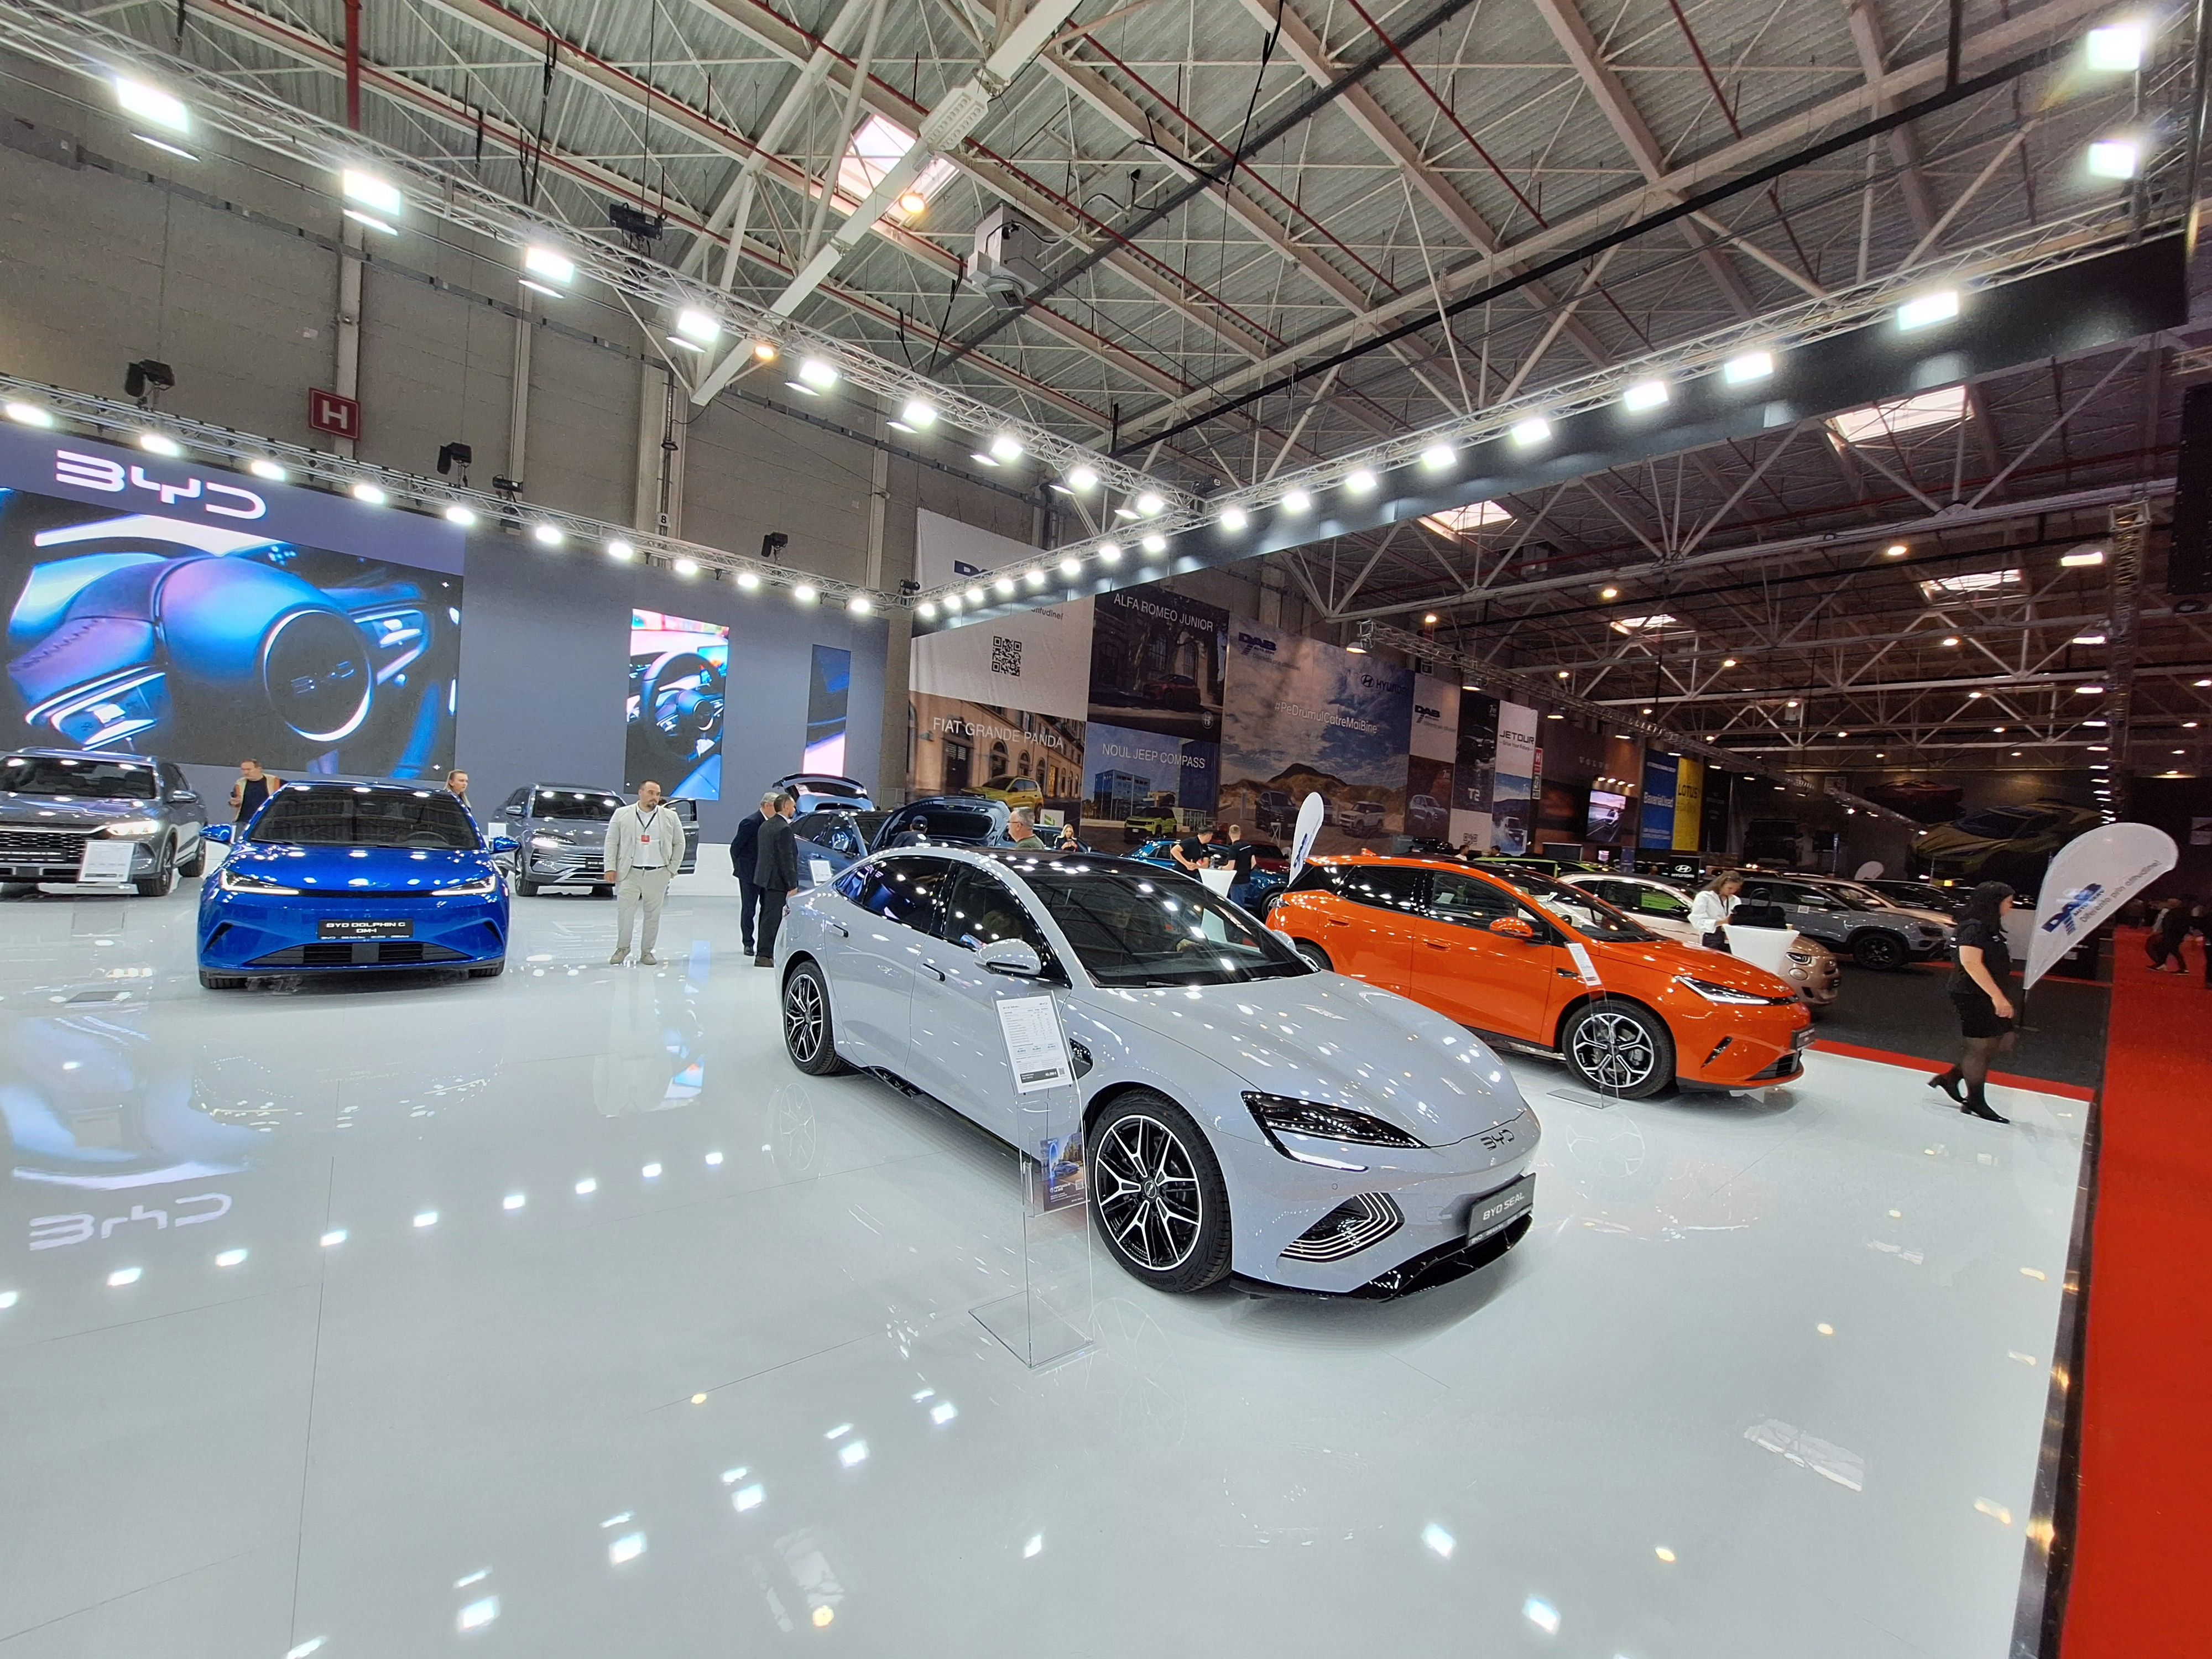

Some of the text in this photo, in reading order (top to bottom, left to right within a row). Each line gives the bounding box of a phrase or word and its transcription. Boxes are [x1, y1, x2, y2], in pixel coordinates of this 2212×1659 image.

[322, 400, 348, 430] H
[56, 449, 267, 520] BYD
[661, 515, 667, 524] 8
[1113, 593, 1214, 633] ALFA ROMEO JUNIOR
[1239, 632, 1277, 651] DAB
[1274, 702, 1378, 734] #PeDrumulCatreMaiBine
[1415, 704, 1440, 718] DAB
[933, 717, 1064, 749] FIAT GRANDE PANDA
[1499, 729, 1535, 745] JETOUR
[1102, 743, 1206, 769] NOUL JEEP COMPASS
[1468, 787, 1480, 802] T2
[1678, 784, 1698, 799] LOTUS
[2042, 883, 2102, 933] DAB
[1480, 1129, 1515, 1151] BYD
[1483, 1203, 1503, 1221] BYD
[1504, 1192, 1525, 1210] SEAL
